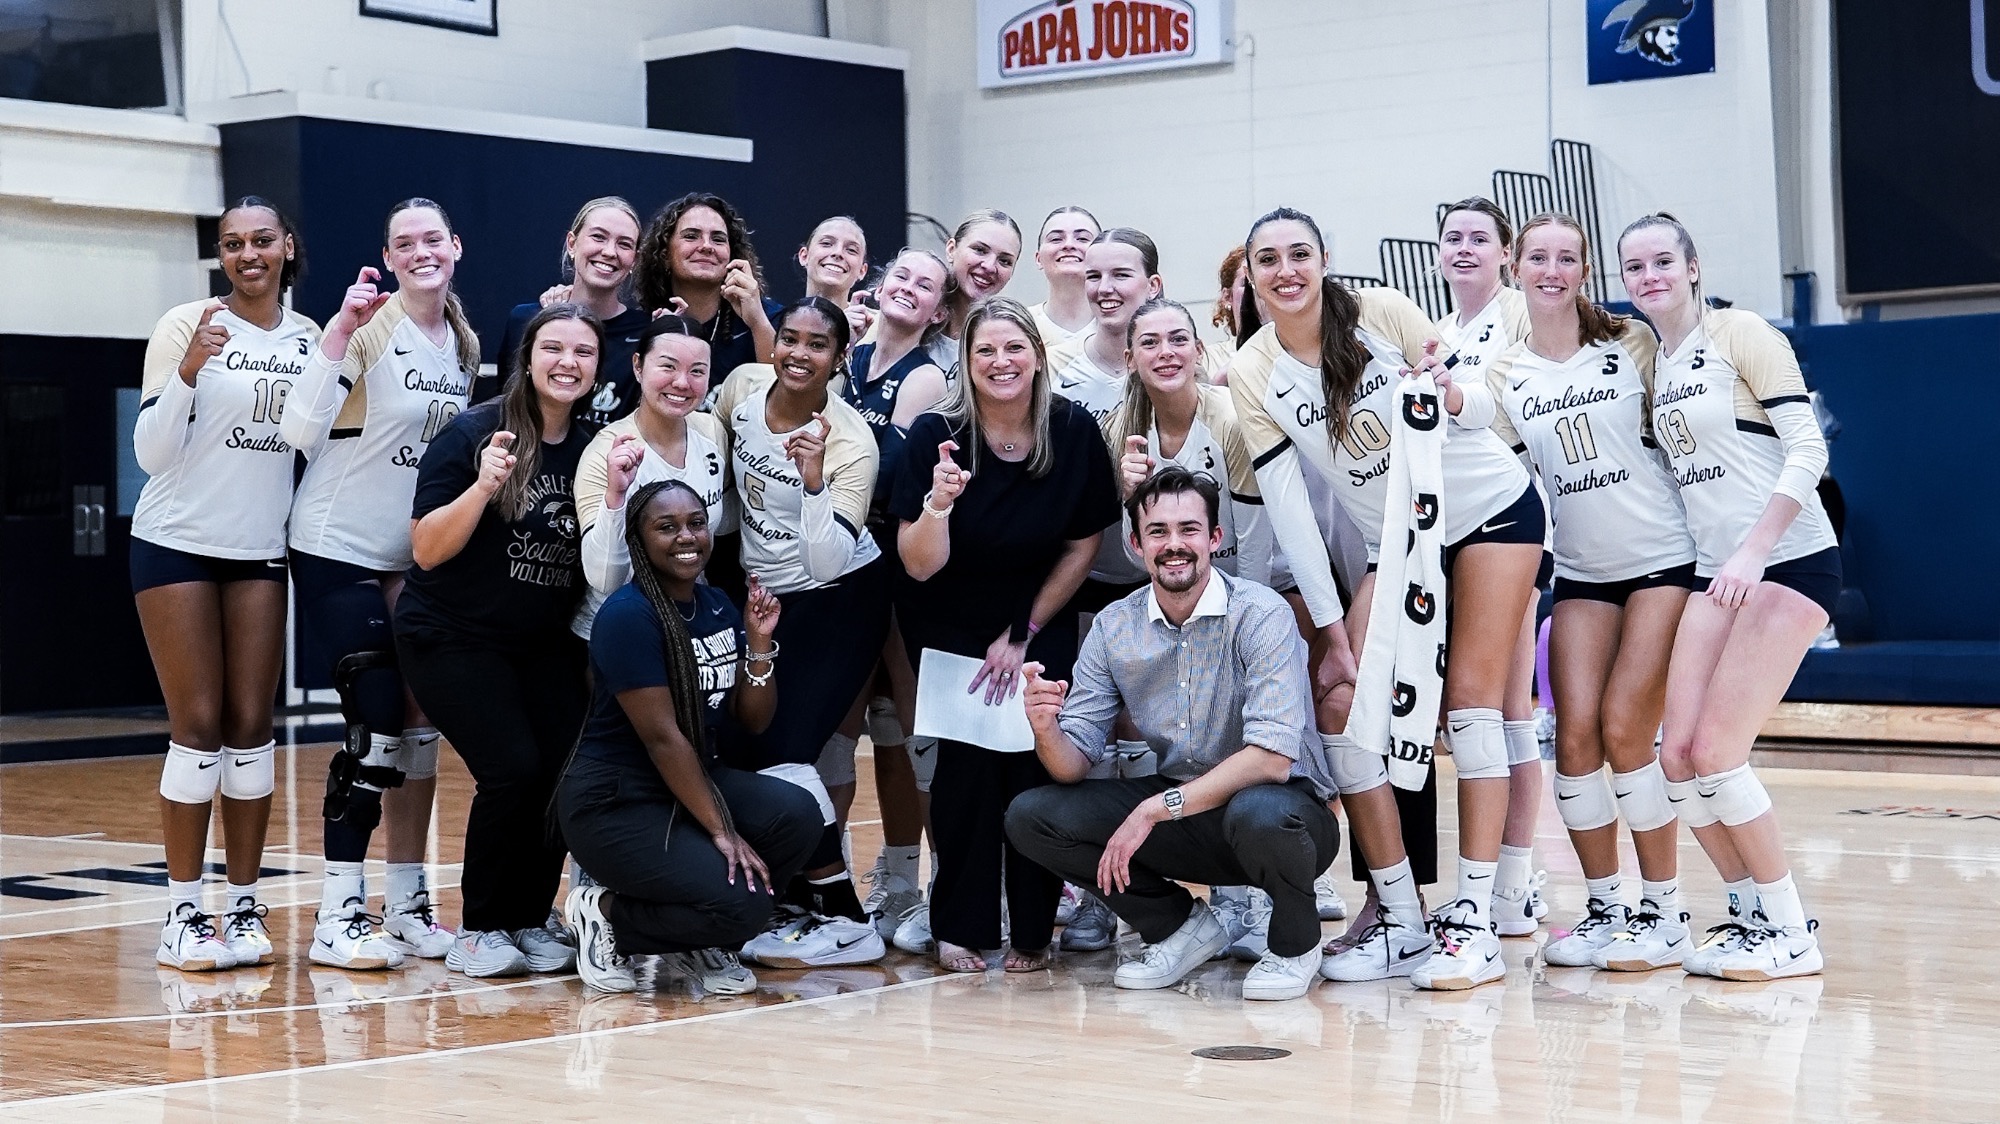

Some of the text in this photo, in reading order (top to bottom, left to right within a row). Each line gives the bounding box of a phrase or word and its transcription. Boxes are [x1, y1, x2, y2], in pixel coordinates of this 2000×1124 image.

[1003, 0, 1190, 69] PAPA JOHNS
[226, 350, 306, 375] Charlesto
[404, 368, 467, 397] Charlesto
[252, 378, 294, 425] 18
[1522, 384, 1620, 422] Charleston
[1554, 412, 1599, 466] 11
[1657, 408, 1698, 459] 13
[743, 471, 766, 512] 5
[1554, 468, 1630, 498] Southern
